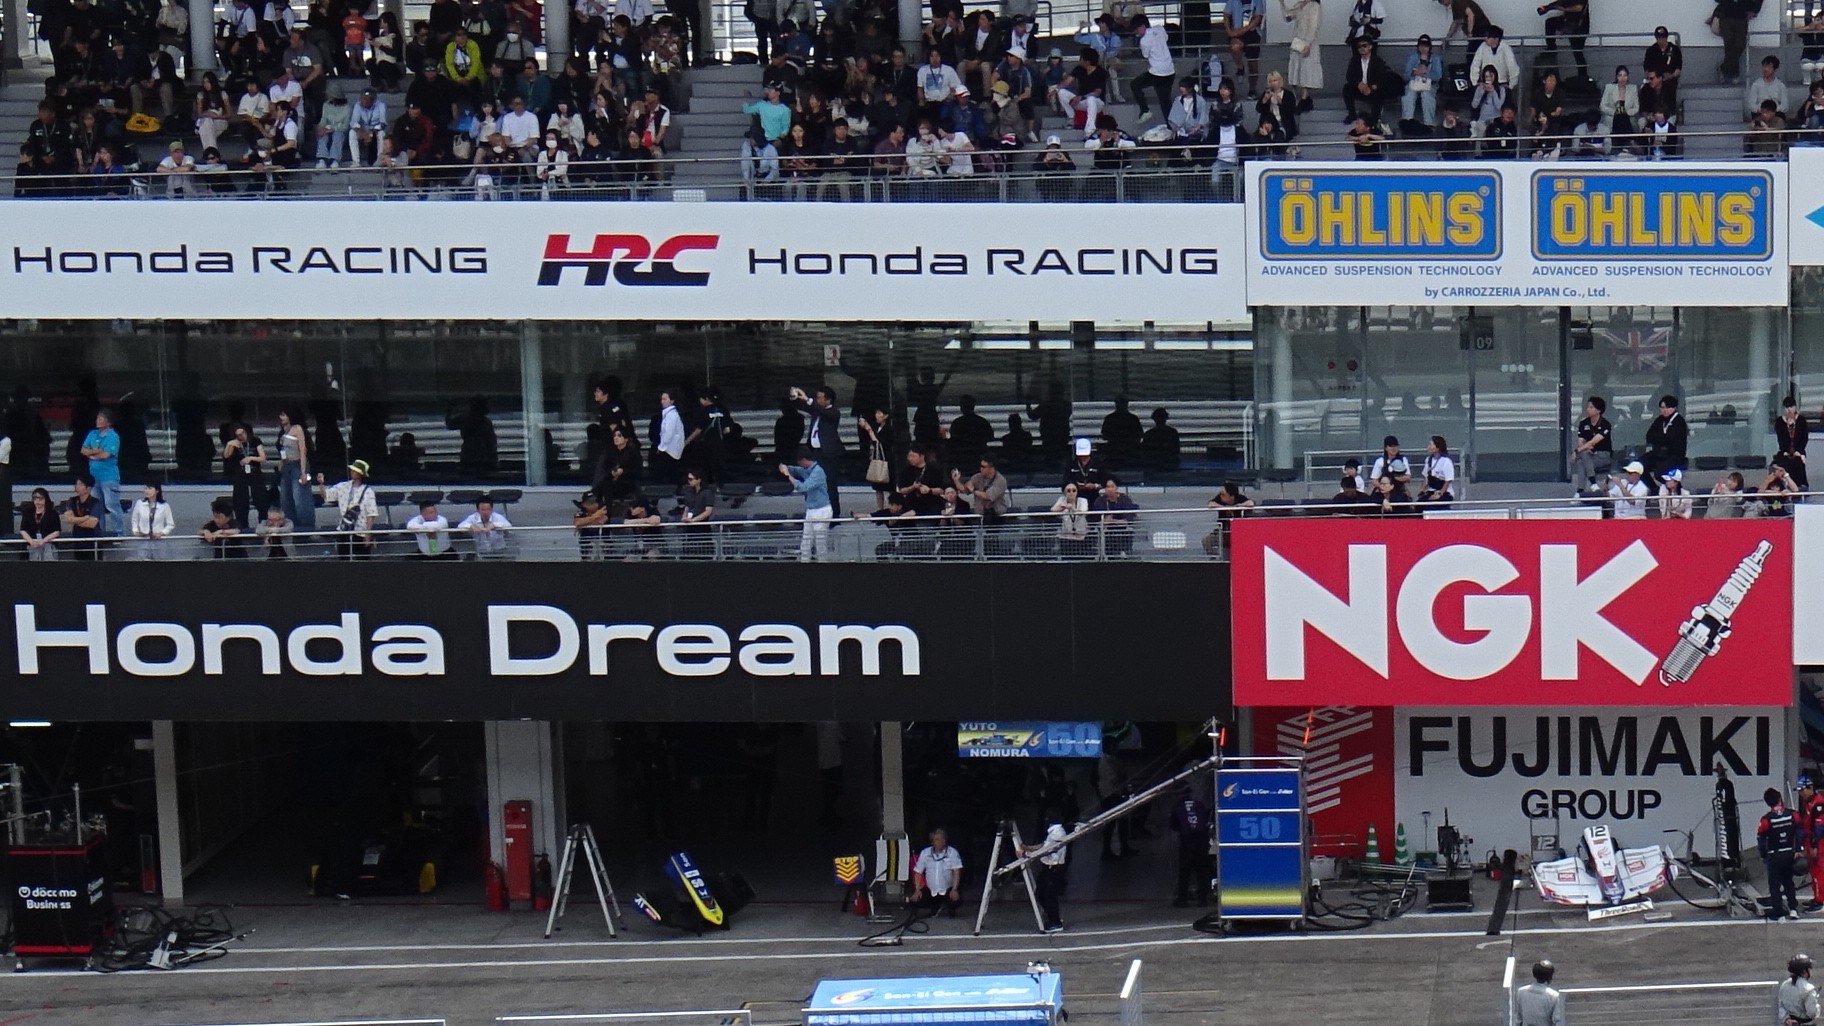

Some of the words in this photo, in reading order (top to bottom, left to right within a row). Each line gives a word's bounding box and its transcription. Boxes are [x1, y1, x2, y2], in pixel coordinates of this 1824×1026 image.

[1280, 178, 1485, 247] ÖHLINS
[1551, 178, 1755, 247] ÖHLINS
[14, 244, 234, 274] Honda
[253, 246, 487, 275] RACING
[538, 233, 720, 287] HRC
[749, 246, 968, 275] Honda
[987, 248, 1218, 275] RACING
[1262, 265, 1327, 276] ADVANCED
[1334, 265, 1412, 276] SUSPENSION
[1418, 265, 1503, 276] TECHNOLOGY
[1532, 266, 1598, 276] ADVANCED
[1605, 266, 1683, 276] SUSPENSION
[1688, 266, 1773, 276] TECHNOLOGY
[1425, 287, 1439, 299] by
[1442, 287, 1522, 298] CARROZZERIA
[1523, 287, 1560, 298] JAPAN
[1263, 539, 1659, 687] NGK
[14, 603, 445, 676] Honda
[486, 604, 920, 676] Dream
[960, 722, 997, 731] YUTO
[970, 748, 1030, 758] NOMURA
[1409, 716, 1770, 778] FUJIMAKI
[1521, 789, 1661, 819] GROUP
[1239, 817, 1281, 840] 50
[1590, 826, 1607, 838] 12
